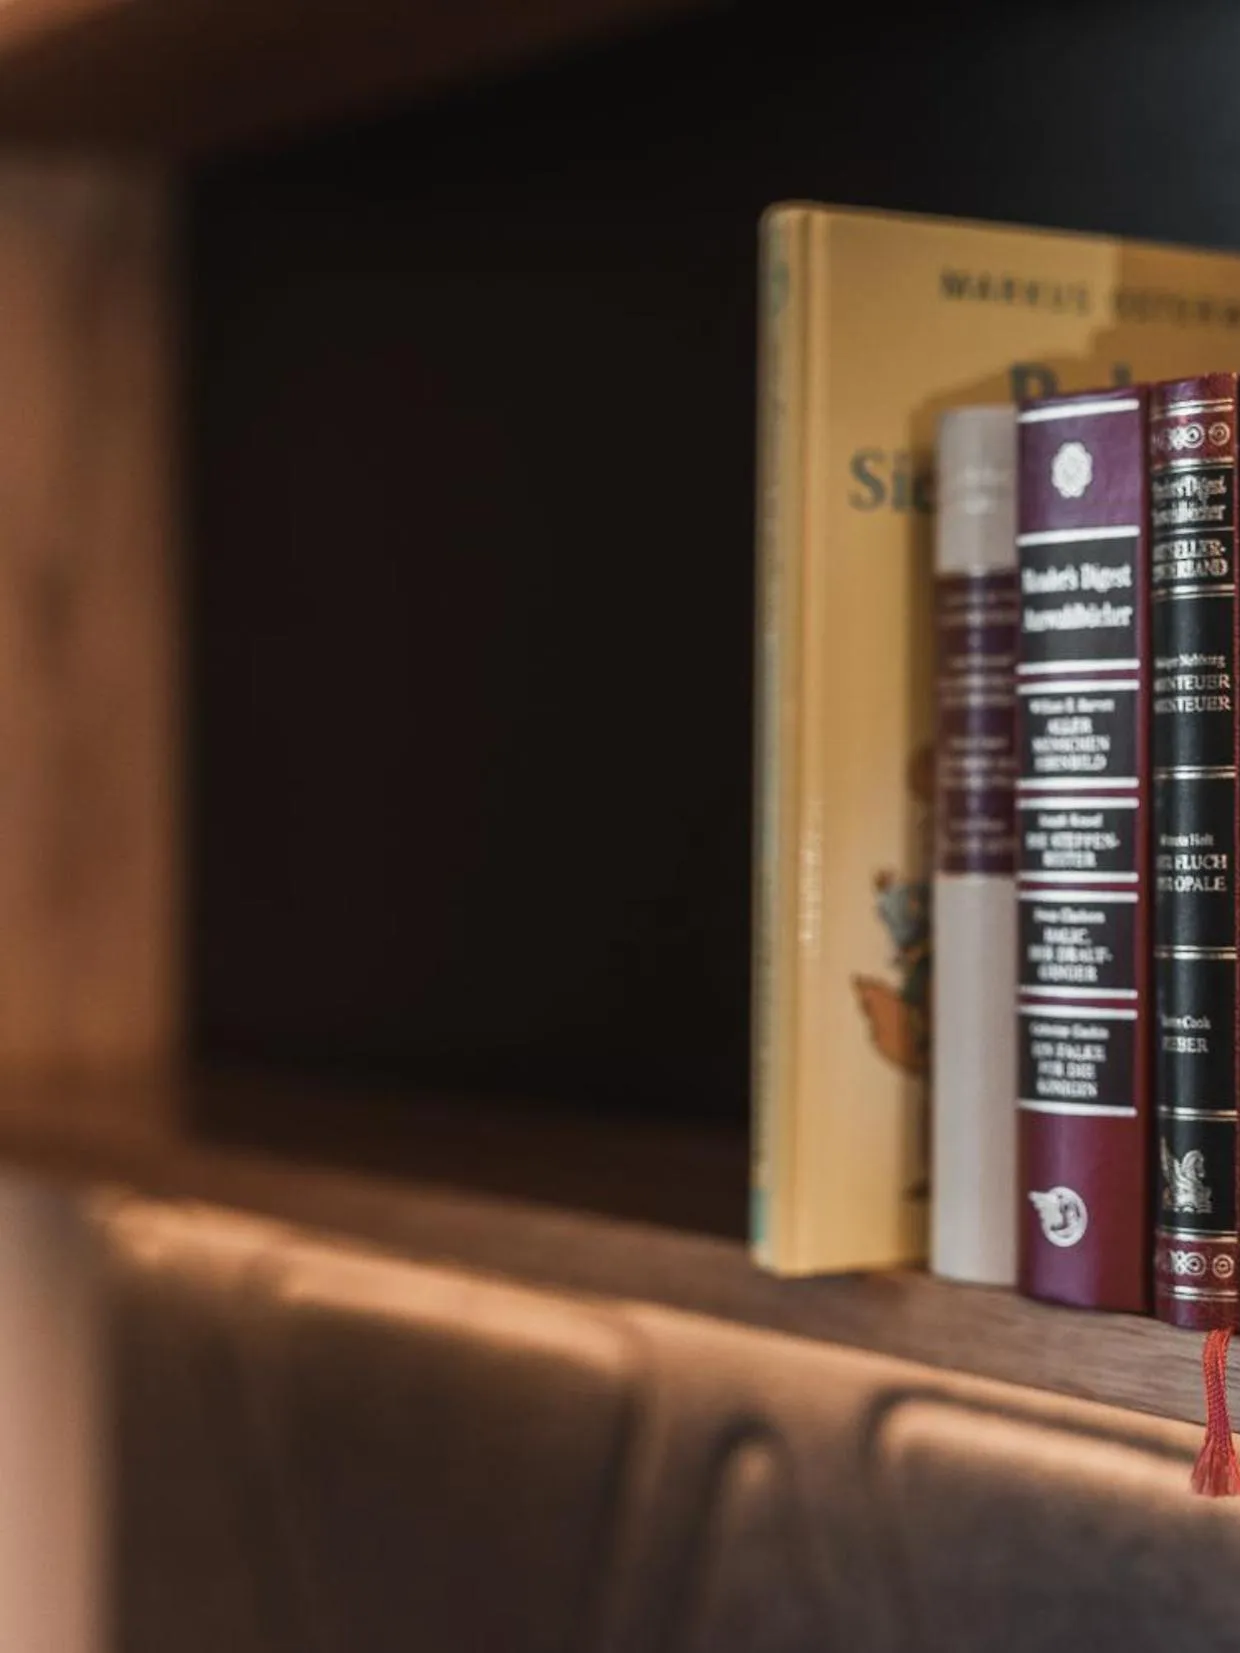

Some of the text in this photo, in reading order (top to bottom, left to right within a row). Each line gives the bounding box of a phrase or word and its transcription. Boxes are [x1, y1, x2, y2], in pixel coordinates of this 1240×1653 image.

[1153, 539, 1226, 562] SELLER-
[1174, 854, 1227, 871] FLUCH
[1174, 876, 1227, 893] OPALE
